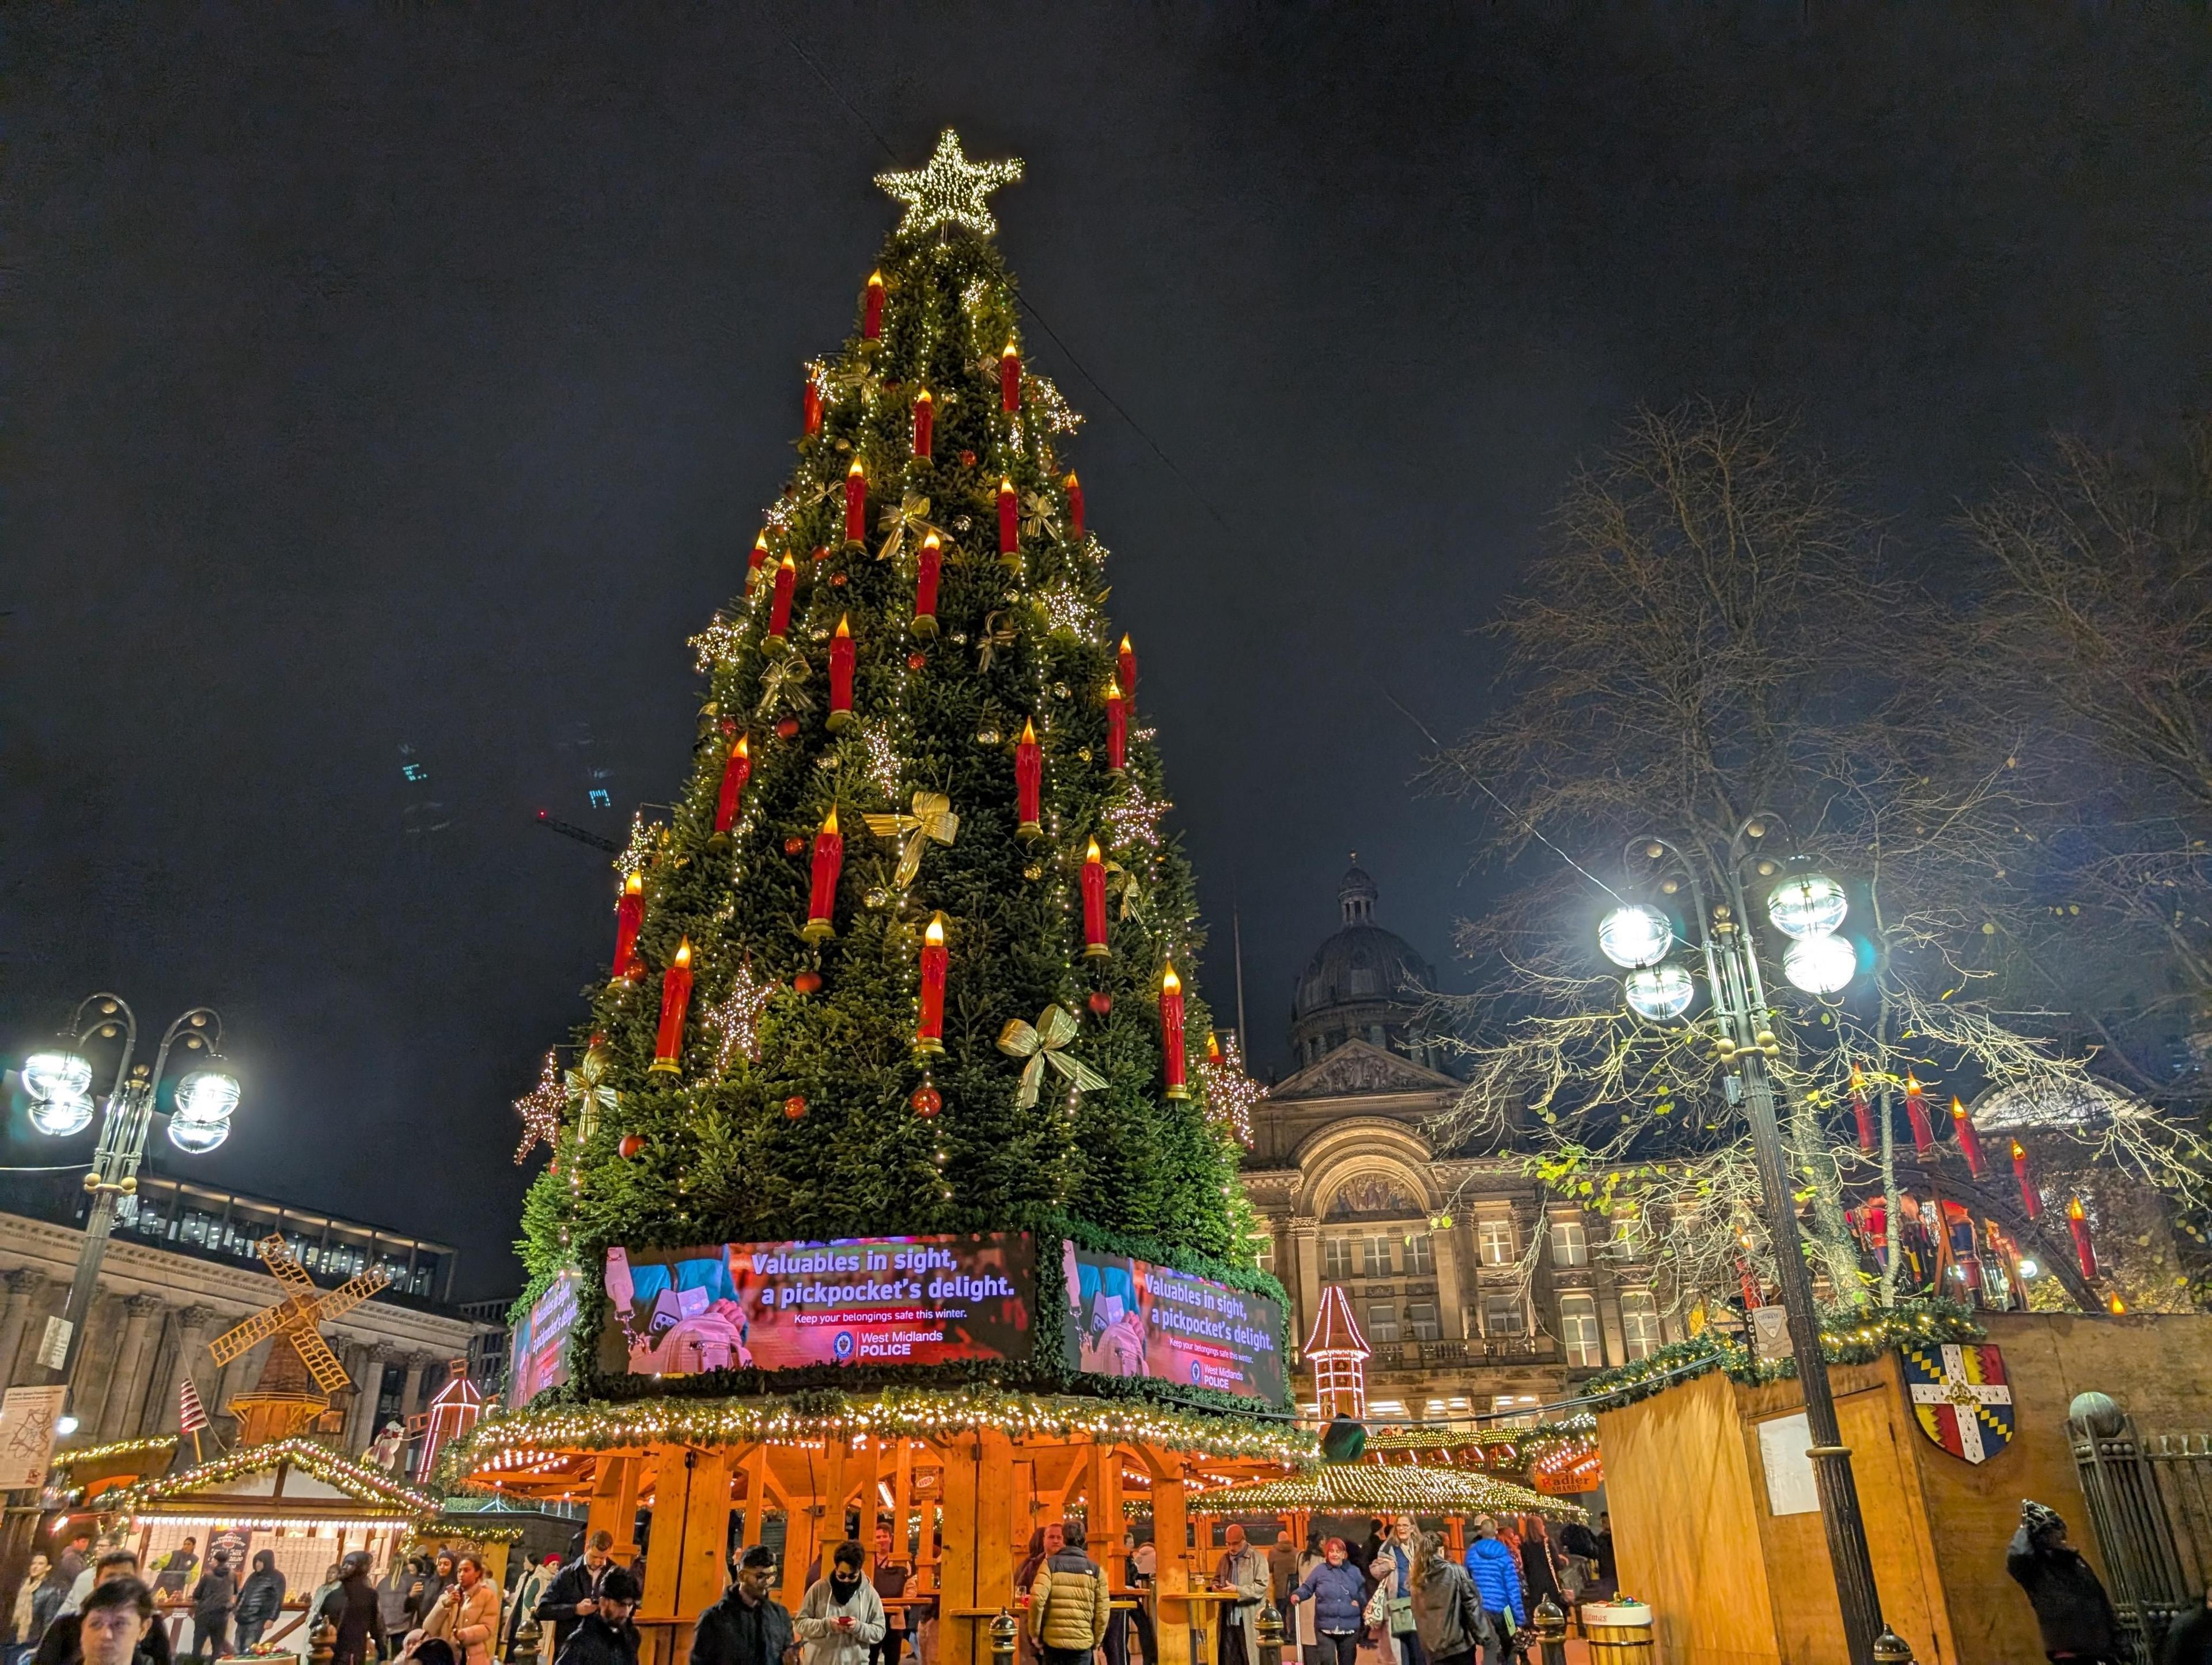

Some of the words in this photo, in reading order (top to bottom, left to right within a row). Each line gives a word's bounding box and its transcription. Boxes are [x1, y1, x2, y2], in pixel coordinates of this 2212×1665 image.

[752, 1251, 859, 1275] Valuables
[867, 1250, 887, 1270] in
[894, 1247, 957, 1274] sight,
[762, 1288, 774, 1304] a
[781, 1278, 922, 1309] pickpocket's
[929, 1275, 1014, 1302] delight.
[1145, 1273, 1201, 1307] Valuables
[1204, 1289, 1214, 1310] in
[1217, 1295, 1247, 1321] sight,
[794, 1314, 817, 1325] Keep
[820, 1314, 840, 1324] your
[843, 1312, 892, 1323] belongings
[895, 1311, 913, 1320] safe
[916, 1310, 933, 1319] this
[935, 1309, 967, 1318] winter.
[861, 1332, 888, 1343] West
[892, 1330, 943, 1342] Midlands
[1152, 1308, 1159, 1323] a
[1162, 1307, 1232, 1341] pickpocket's
[1234, 1325, 1273, 1352] delight.
[1746, 1314, 1759, 1355] CCTV
[860, 1344, 911, 1356] POLICE
[1169, 1337, 1183, 1349] Keep
[1183, 1342, 1194, 1350] your
[1194, 1343, 1219, 1357] belongings
[1219, 1348, 1229, 1358] safe
[1229, 1351, 1238, 1360] this
[1204, 1363, 1218, 1375] West
[1219, 1367, 1244, 1381] Midlands
[1204, 1375, 1229, 1389] POLICE
[919, 1477, 932, 1486] AVOID
[1541, 1475, 1590, 1488] Radler
[1552, 1485, 1581, 1493] SHANDY
